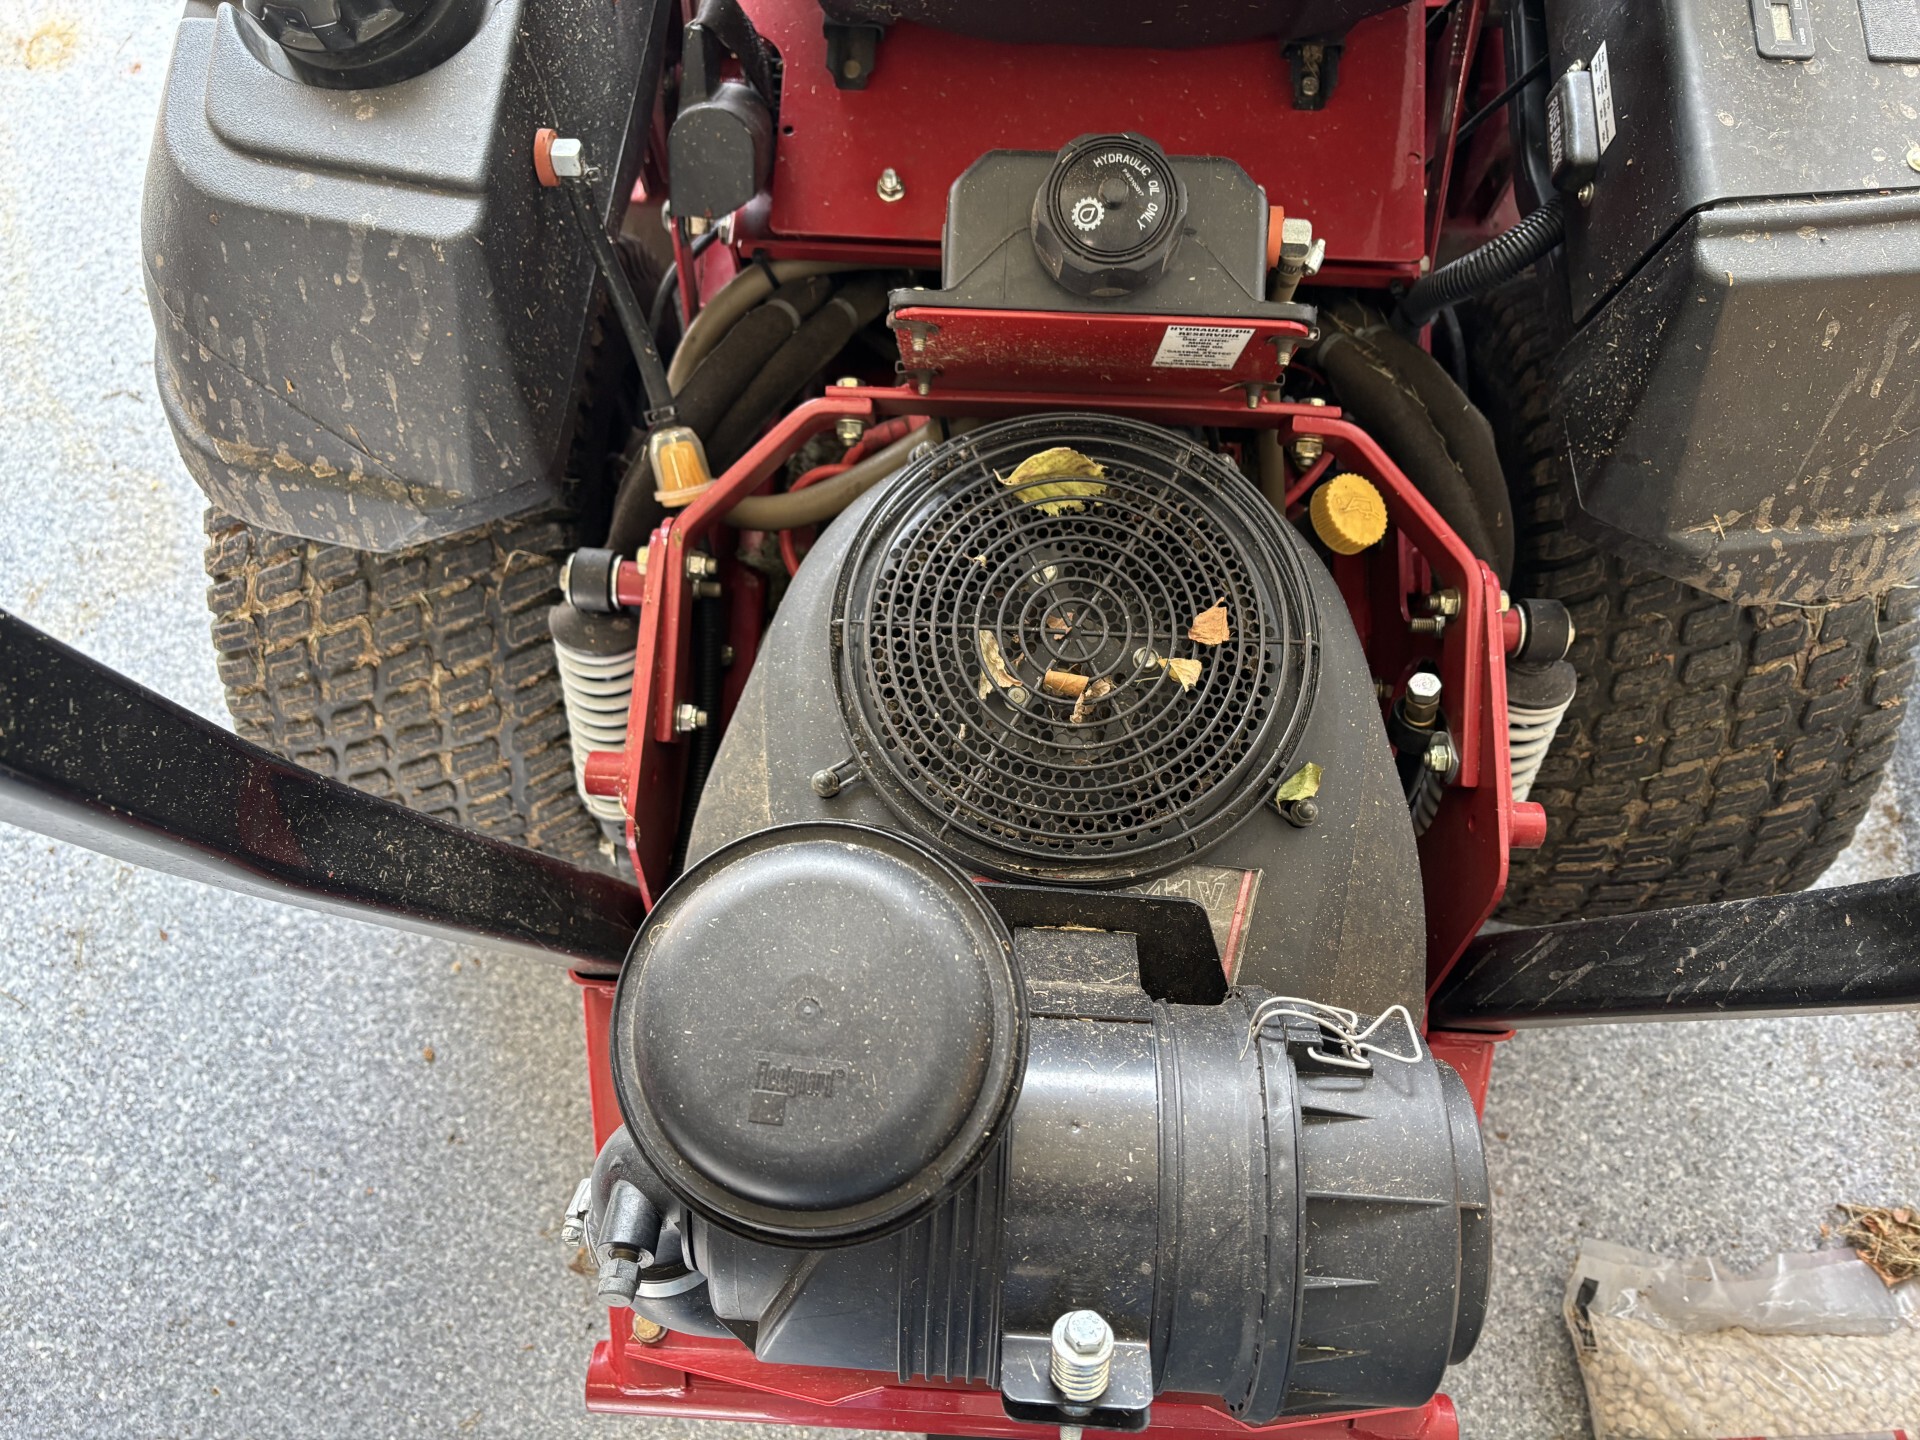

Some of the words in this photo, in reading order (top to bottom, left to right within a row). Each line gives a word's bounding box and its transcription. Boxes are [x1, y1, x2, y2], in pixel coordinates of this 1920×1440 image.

[1548, 96, 1560, 133] FUSE
[1551, 125, 1562, 172] BLOCK
[1093, 153, 1151, 177] HYDRAULIC
[1148, 180, 1160, 196] OIL
[1137, 202, 1158, 231] ONLY
